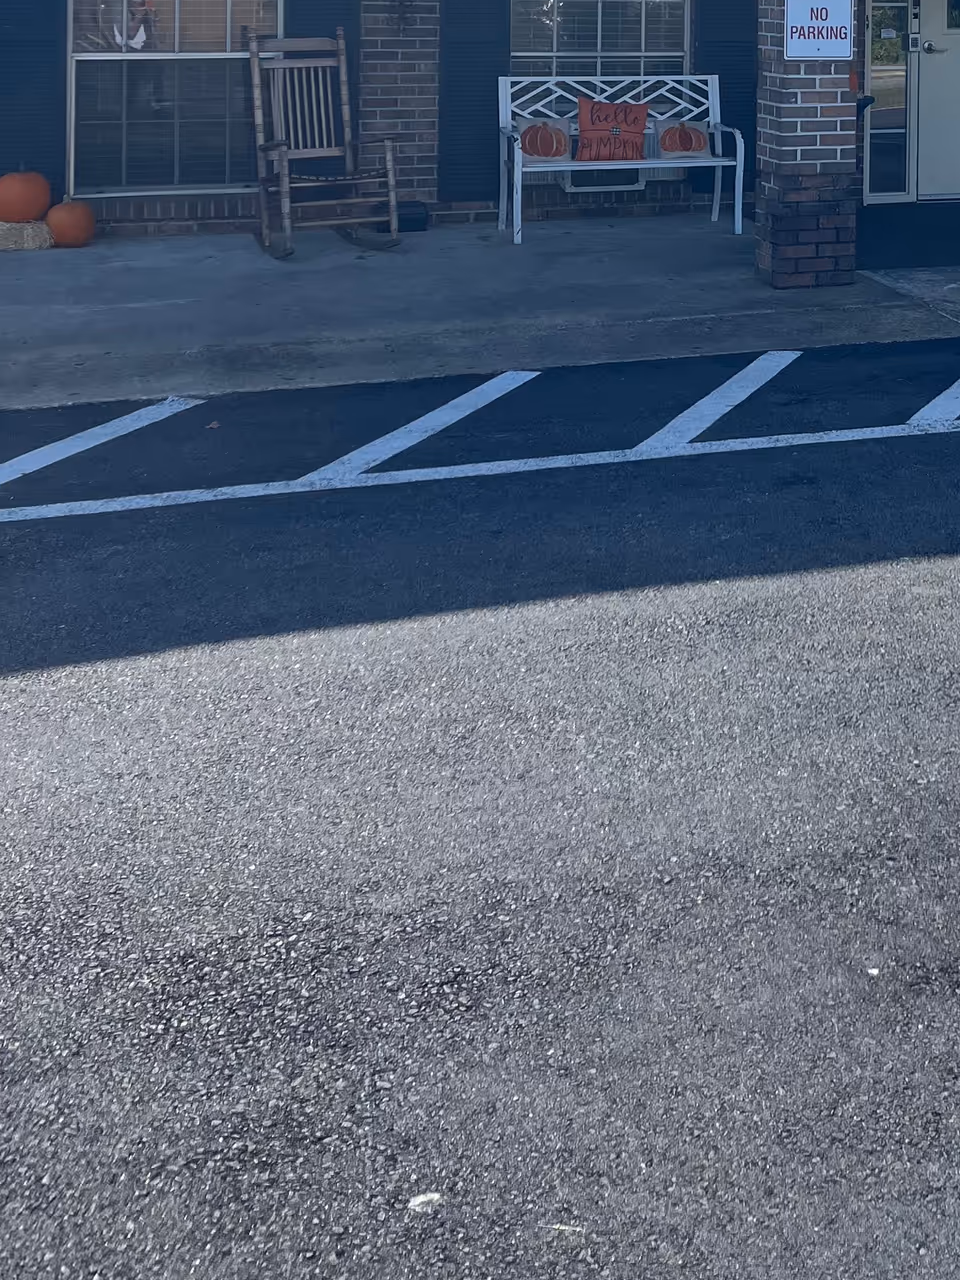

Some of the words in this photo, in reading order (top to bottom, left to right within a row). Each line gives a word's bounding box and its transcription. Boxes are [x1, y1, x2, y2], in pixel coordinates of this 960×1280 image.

[810, 7, 829, 22] NO
[790, 25, 848, 40] PARKING
[590, 102, 641, 127] hello
[579, 137, 645, 160] PUMPKIN
